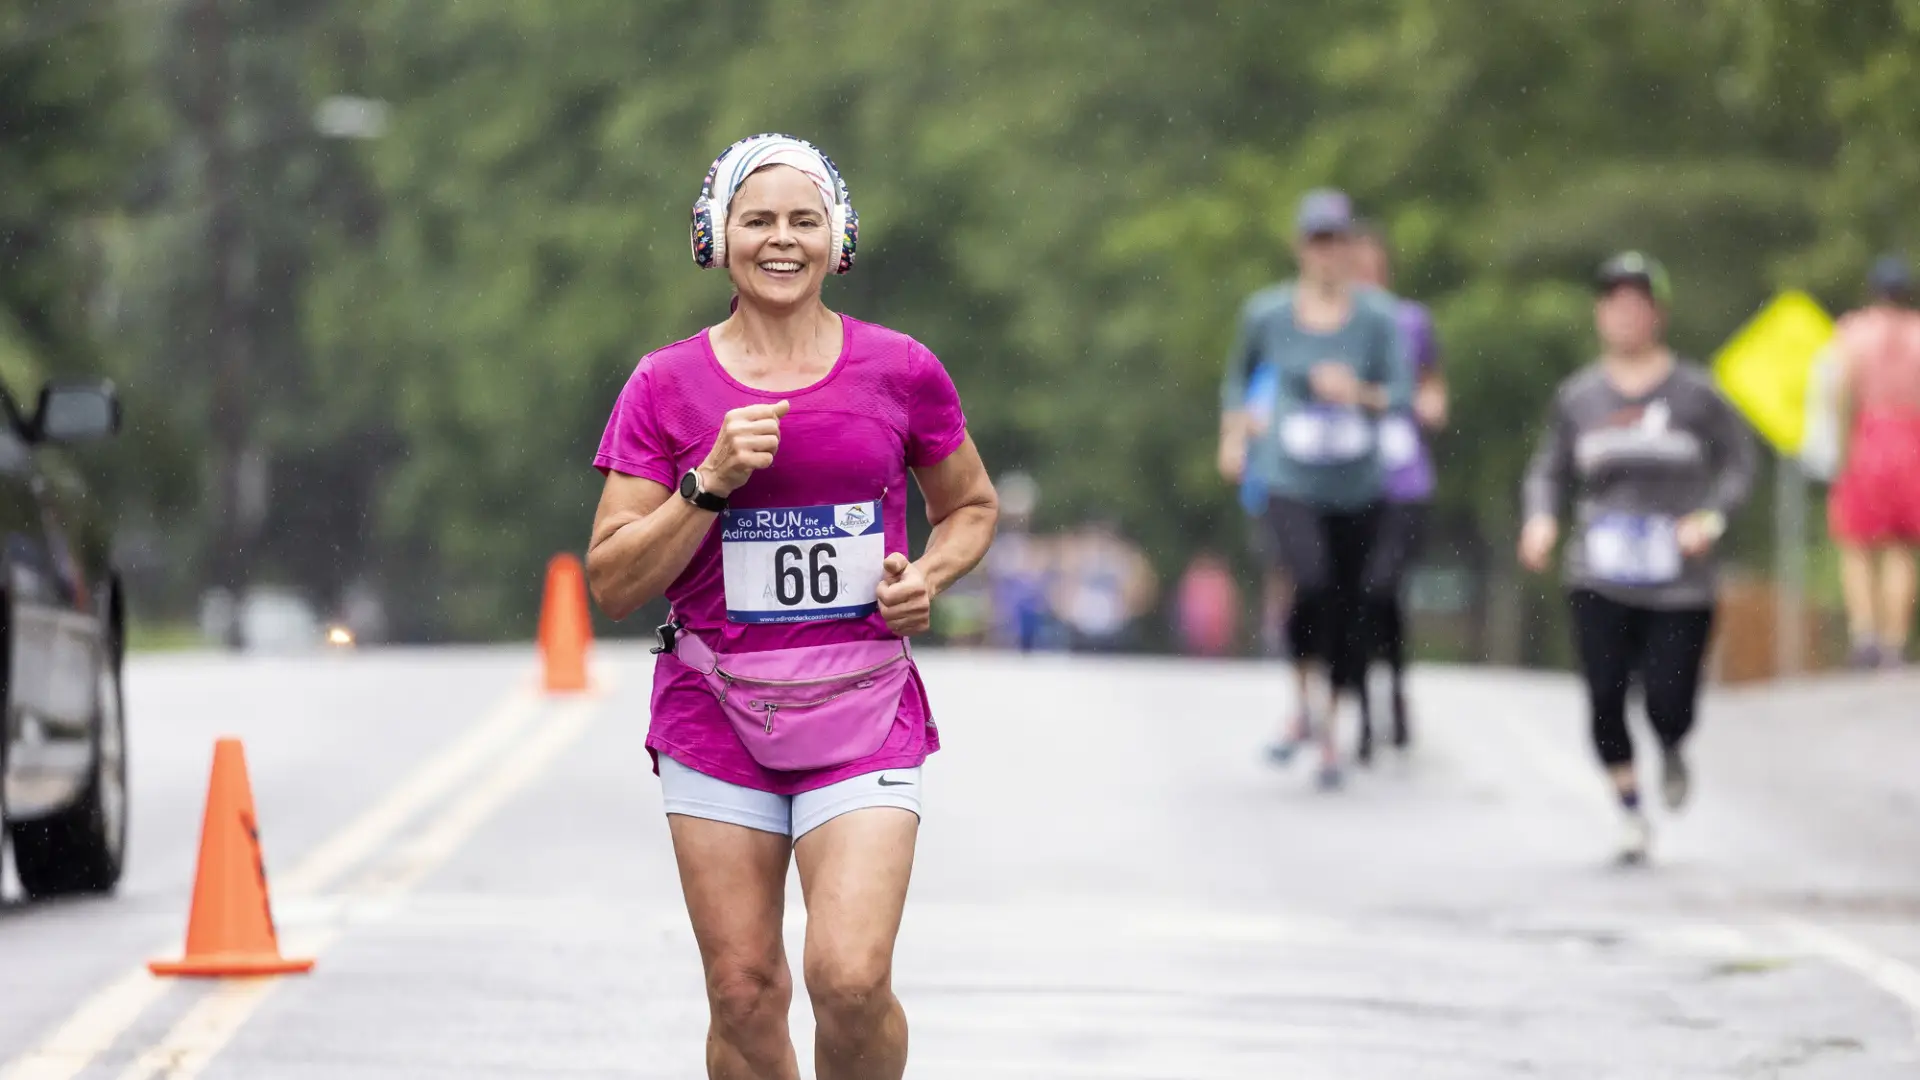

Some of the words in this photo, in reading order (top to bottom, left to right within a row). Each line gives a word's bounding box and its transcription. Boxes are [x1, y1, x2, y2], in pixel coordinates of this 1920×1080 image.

[737, 518, 752, 527] Go
[756, 511, 802, 528] RUN
[722, 526, 794, 540] Adirondack
[799, 524, 835, 537] Coast
[775, 542, 838, 606] 66
[759, 612, 856, 622] www.adirondackcoastevents.com
